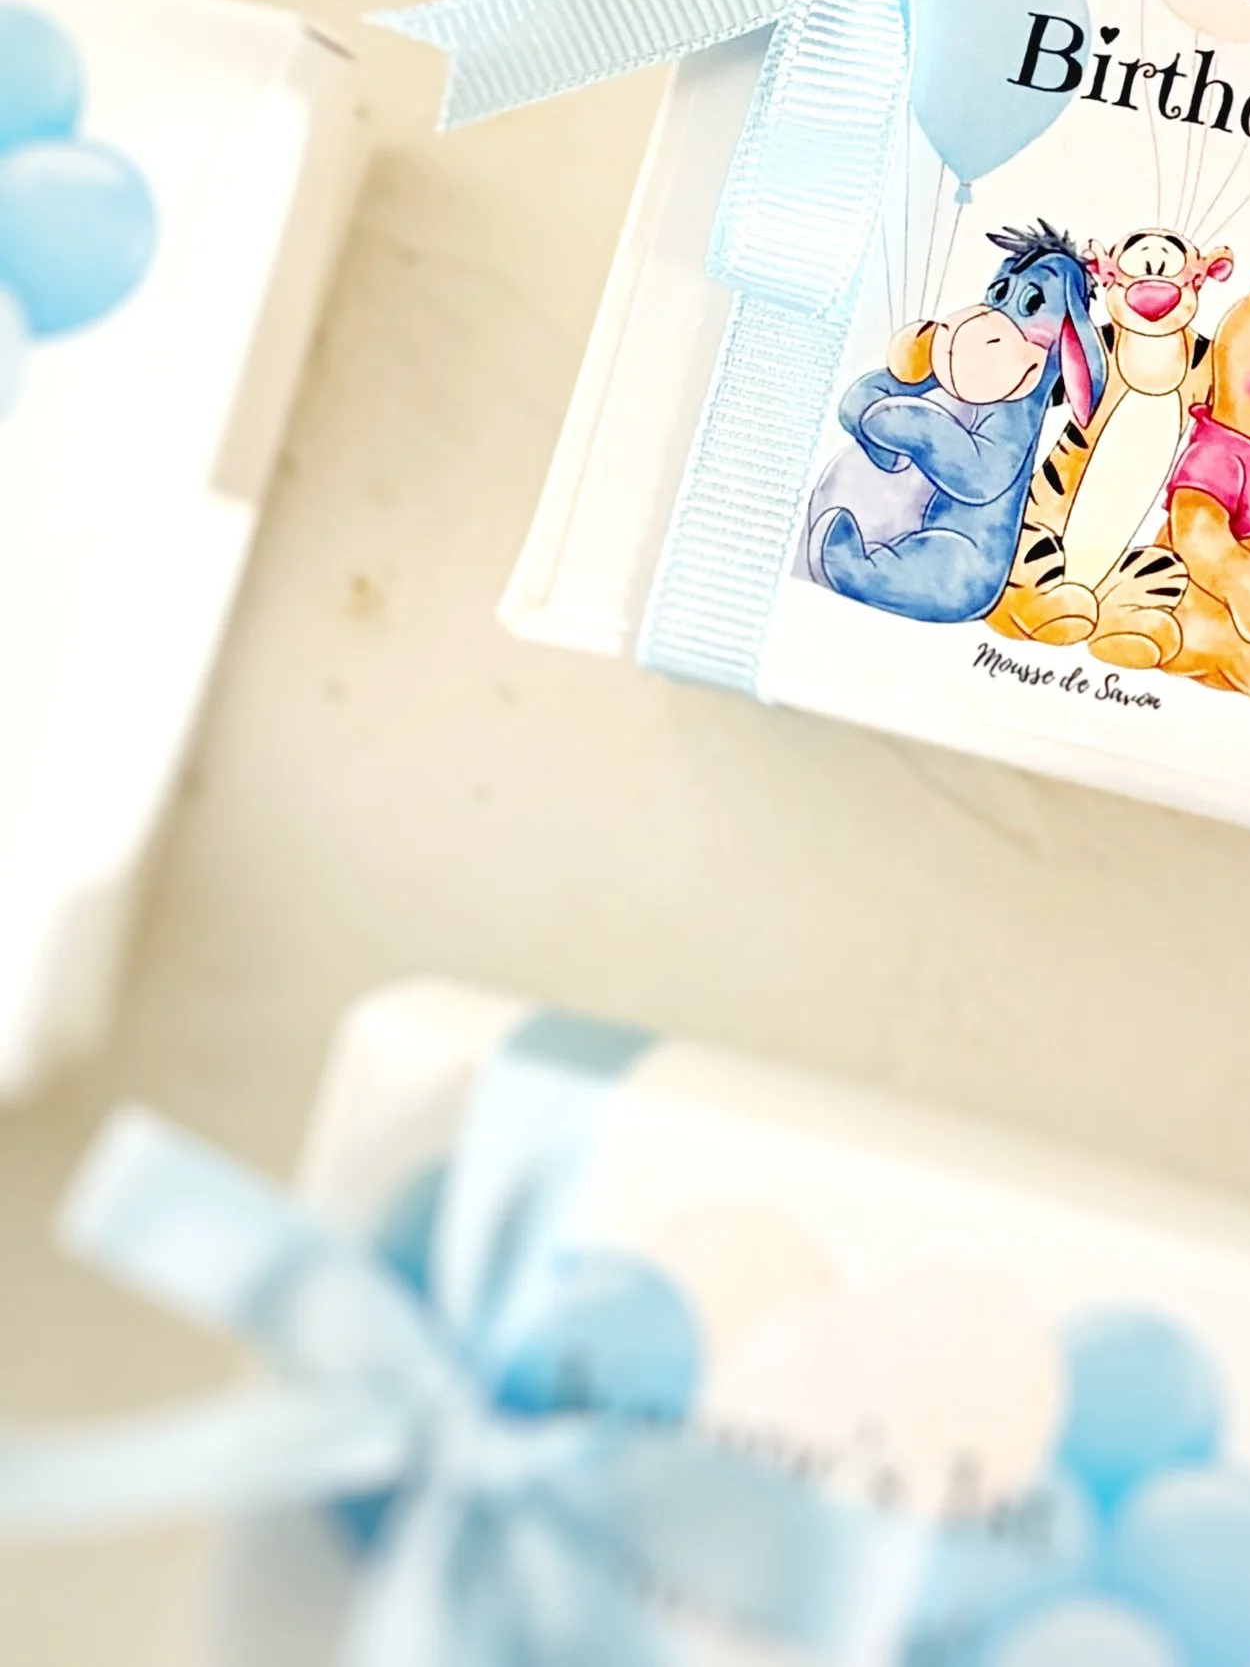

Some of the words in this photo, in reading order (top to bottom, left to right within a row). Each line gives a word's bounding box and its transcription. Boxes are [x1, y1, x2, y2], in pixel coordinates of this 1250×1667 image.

[972, 642, 1055, 686] Mousse
[1059, 666, 1090, 694] de
[1094, 673, 1162, 710] Savon
